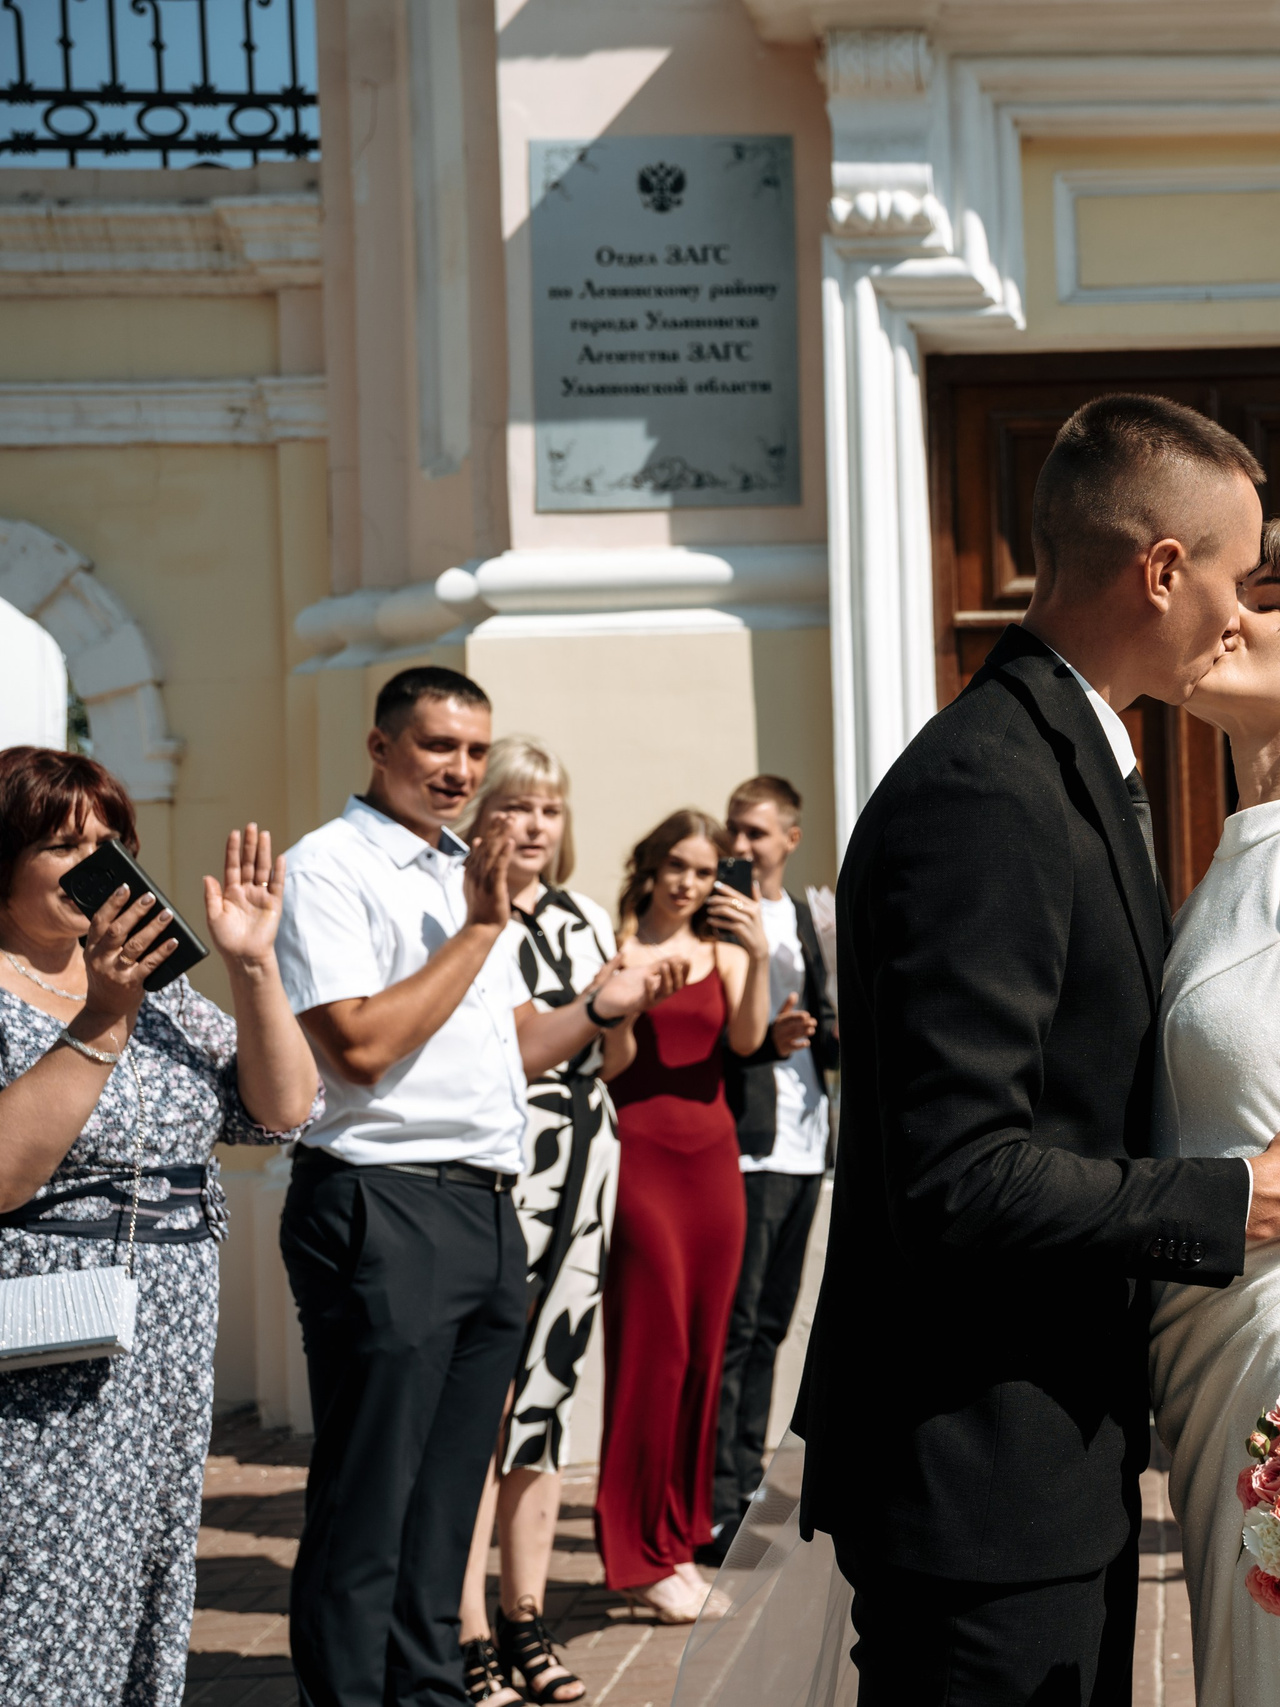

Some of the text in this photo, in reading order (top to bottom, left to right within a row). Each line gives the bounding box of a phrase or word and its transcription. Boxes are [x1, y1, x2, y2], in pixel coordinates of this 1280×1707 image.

[595, 243, 731, 267] Отдел ЗАГС
[548, 279, 780, 301] по Ленинскому району
[570, 310, 760, 335] города Ульяновска
[577, 341, 752, 364] Агентства ЗАГС
[561, 376, 772, 397] Ульяновской области
